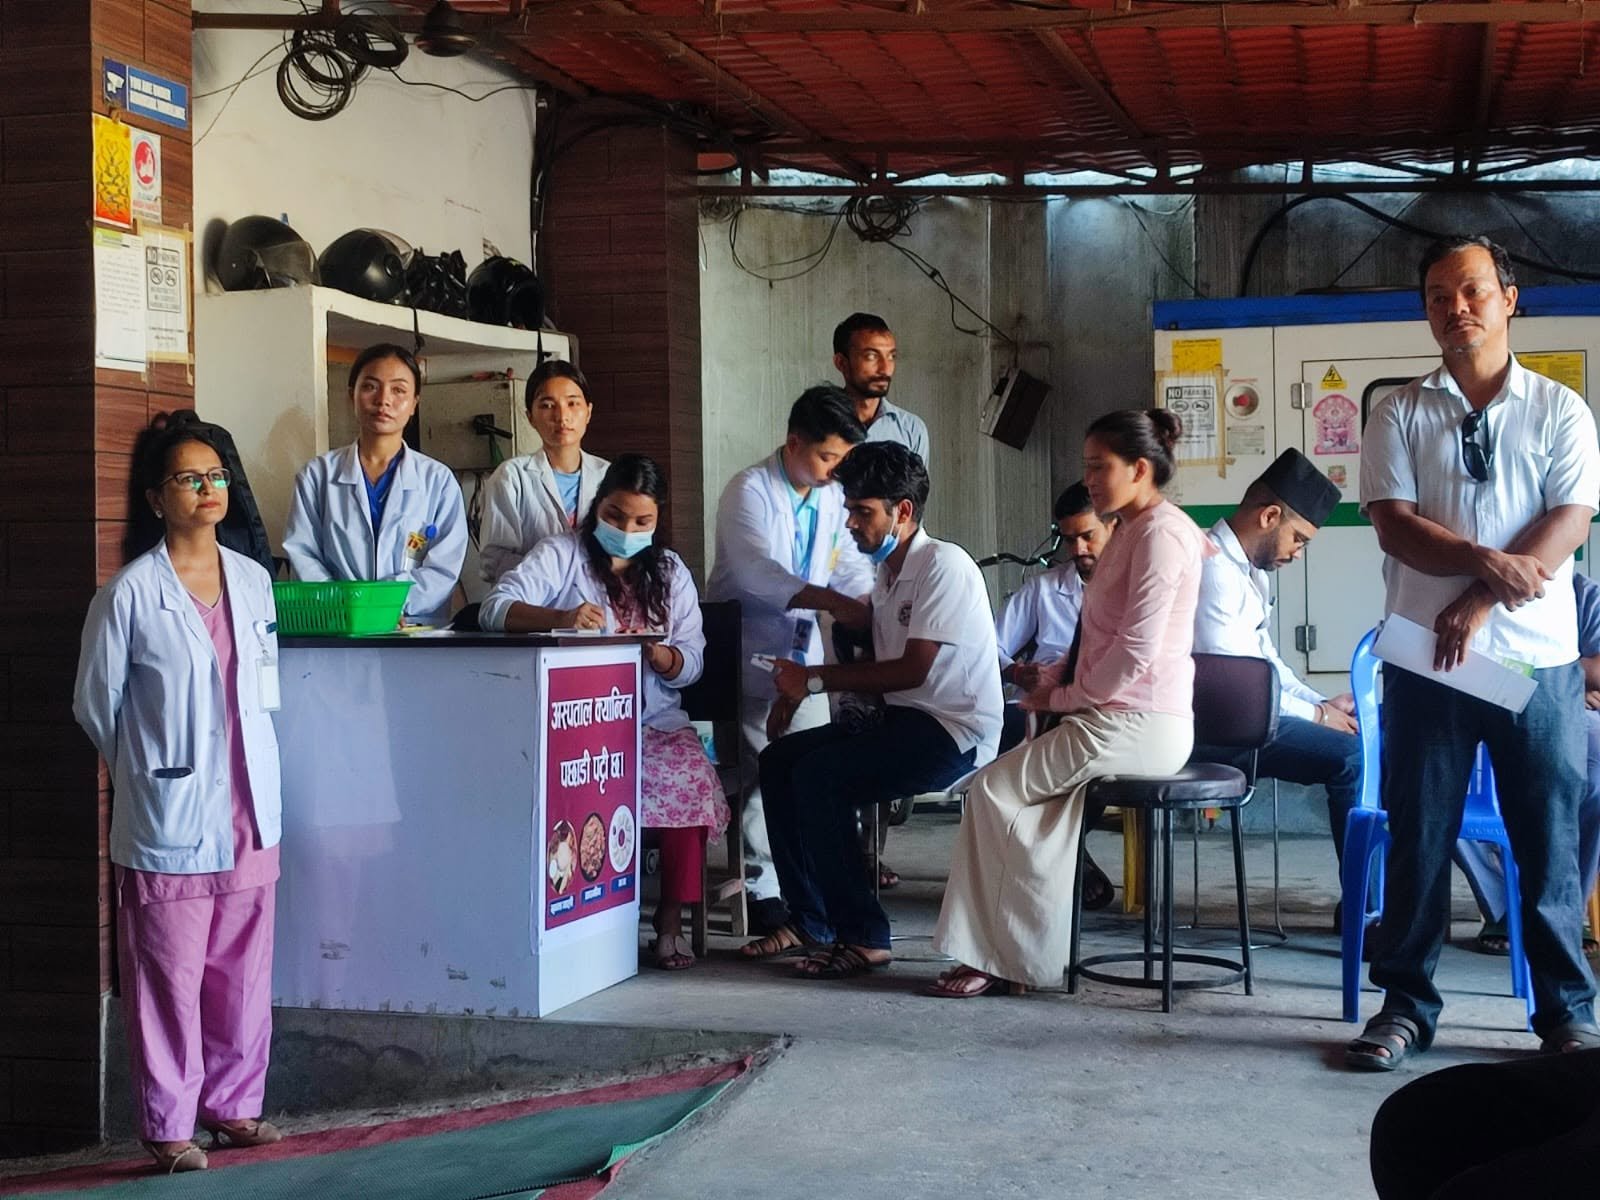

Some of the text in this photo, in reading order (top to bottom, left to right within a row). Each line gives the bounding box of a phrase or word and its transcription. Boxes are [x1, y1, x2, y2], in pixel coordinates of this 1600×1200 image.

[1168, 388, 1181, 398] NO
[551, 686, 633, 730] अस्पताल क्यान्टिन
[560, 749, 591, 788] पछाडी
